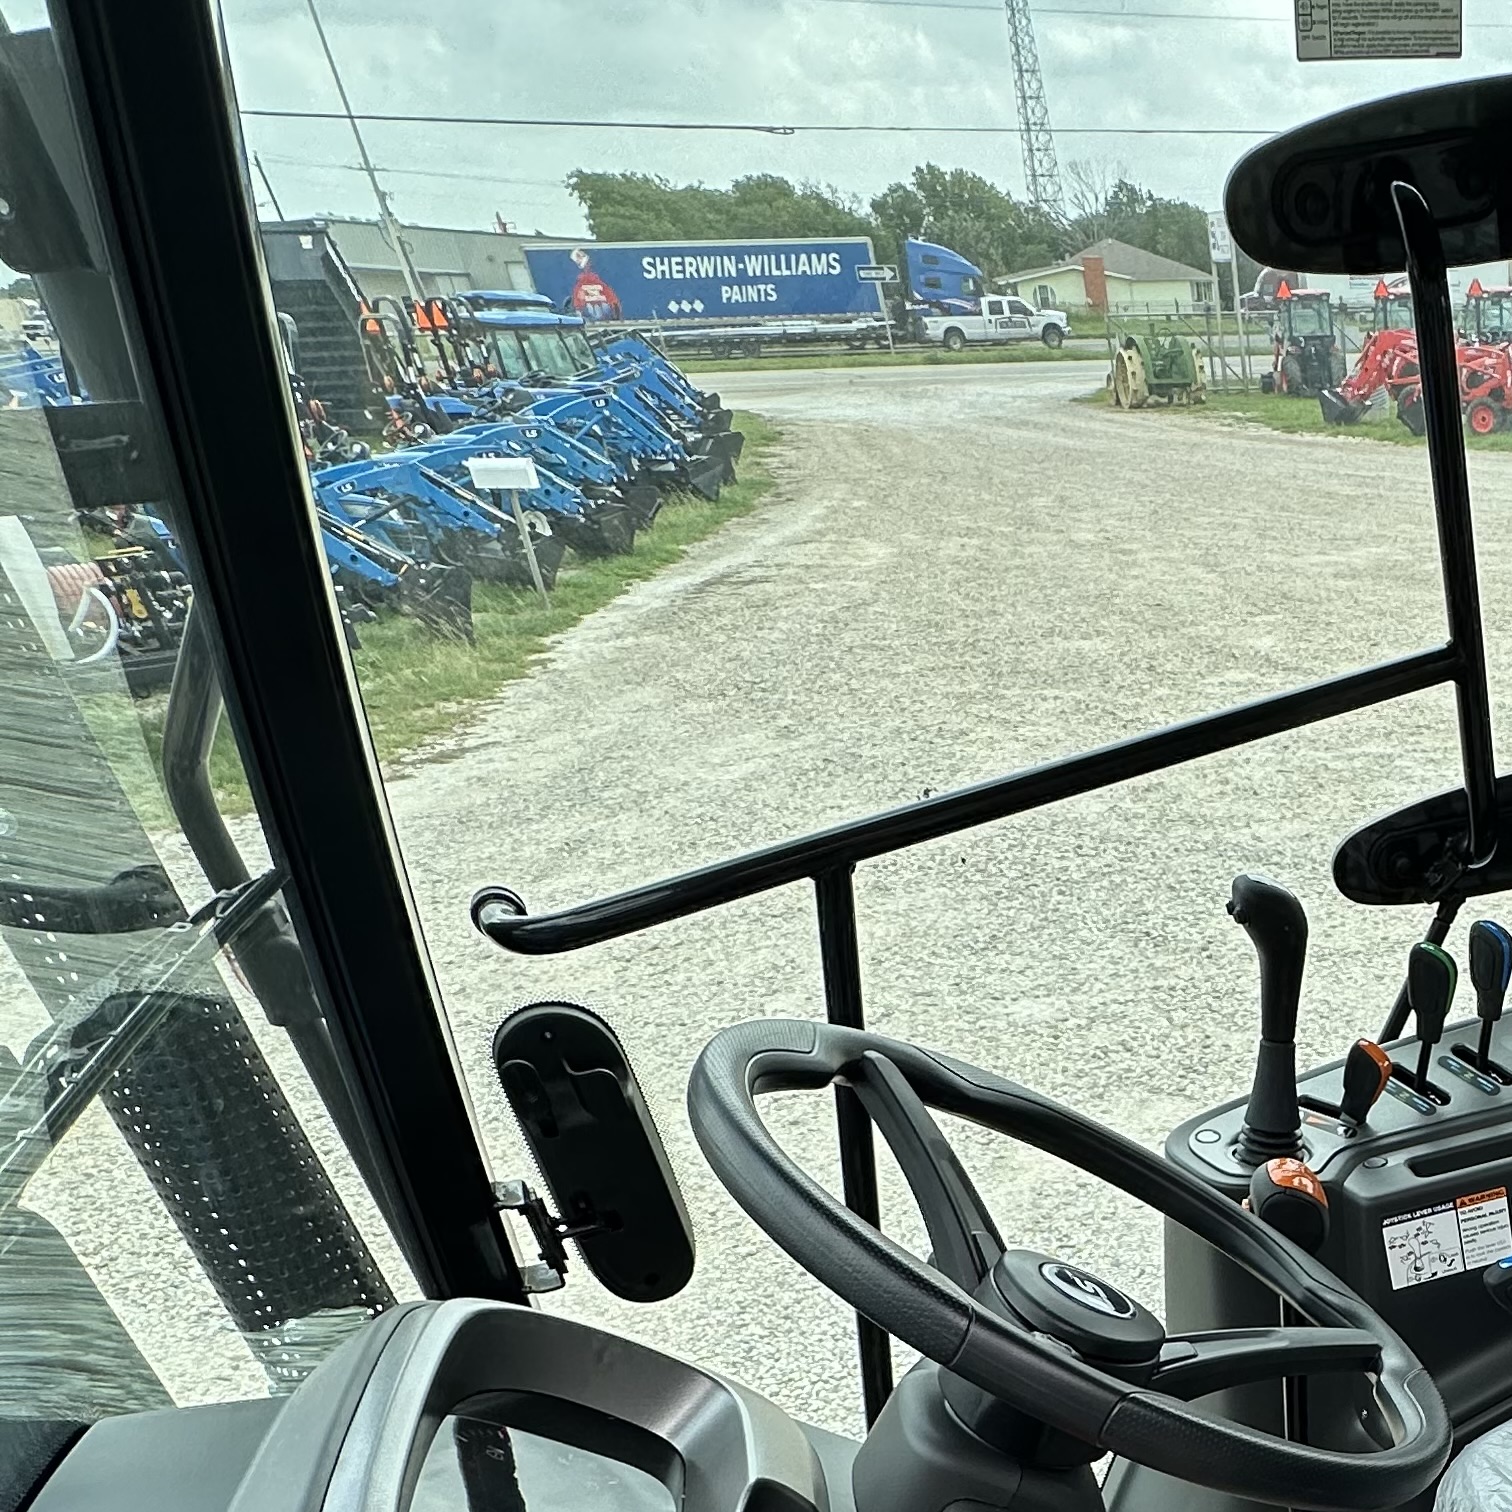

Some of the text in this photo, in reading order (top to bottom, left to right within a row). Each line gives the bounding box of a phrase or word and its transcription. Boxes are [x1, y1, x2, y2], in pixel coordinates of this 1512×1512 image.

[641, 252, 842, 280] SHERWIN-WILLIAMS
[721, 284, 778, 304] PAINTS
[525, 429, 538, 438] LS
[341, 483, 353, 492] LS
[1467, 1189, 1505, 1204] WARNING
[1412, 1208, 1433, 1218] LEVER
[1433, 1202, 1455, 1213] USAGE
